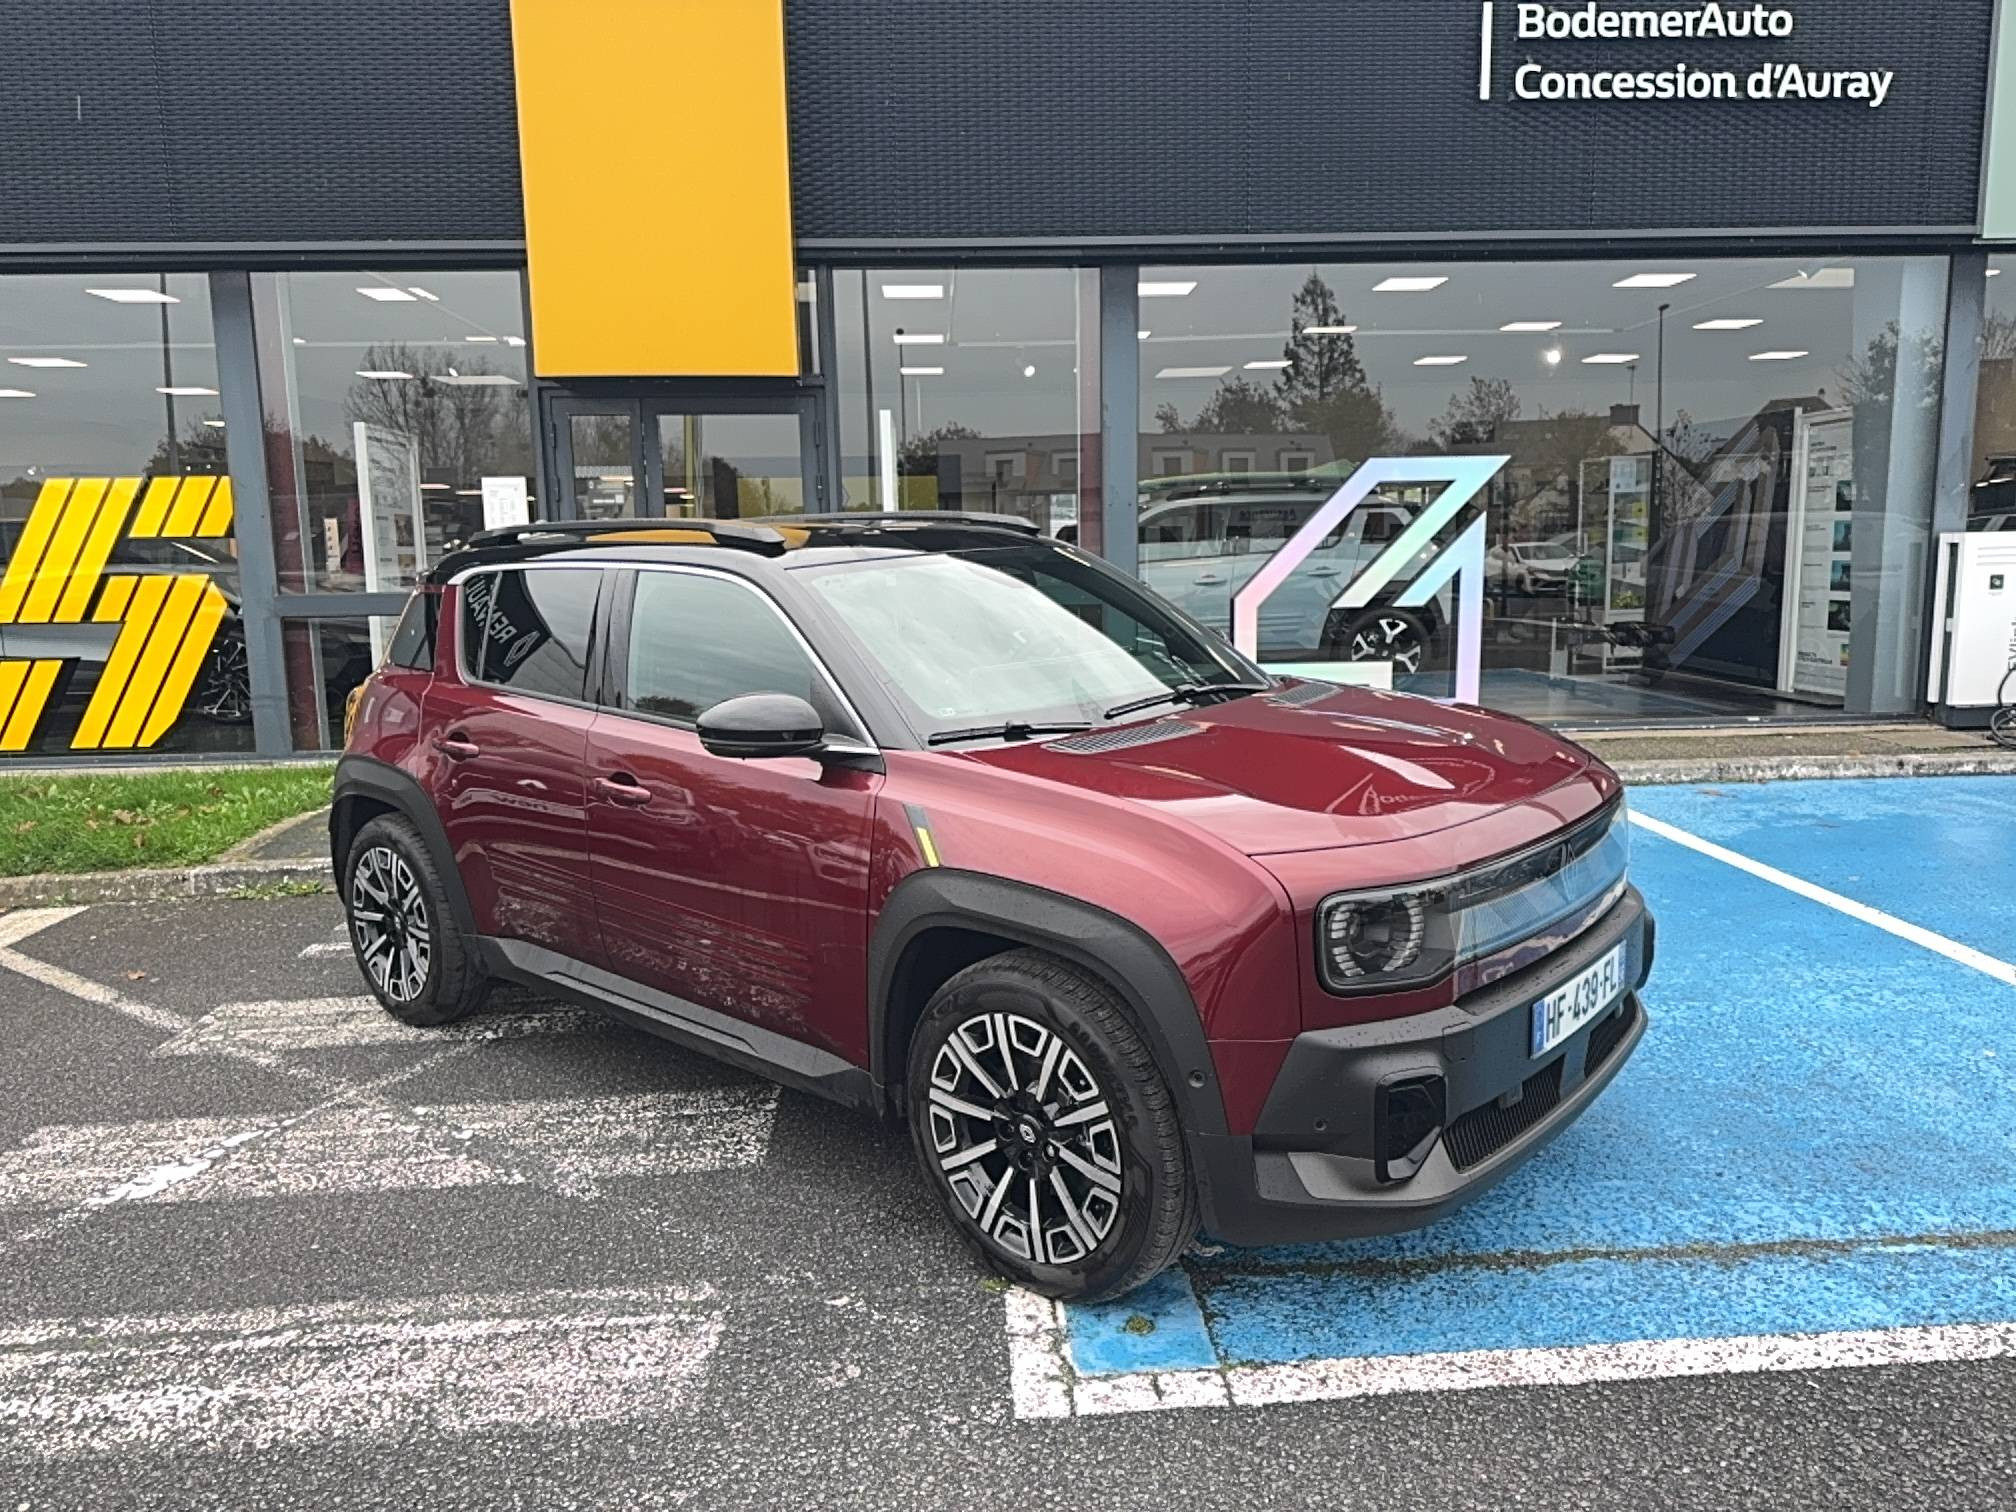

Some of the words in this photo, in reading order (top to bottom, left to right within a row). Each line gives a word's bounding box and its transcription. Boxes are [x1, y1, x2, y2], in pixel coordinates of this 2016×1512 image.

[1517, 1, 1794, 38] BodemerAuto
[1515, 63, 1738, 100] Concession
[1747, 62, 1894, 107] d'Auray
[1545, 955, 1617, 1043] HF-439-FL
